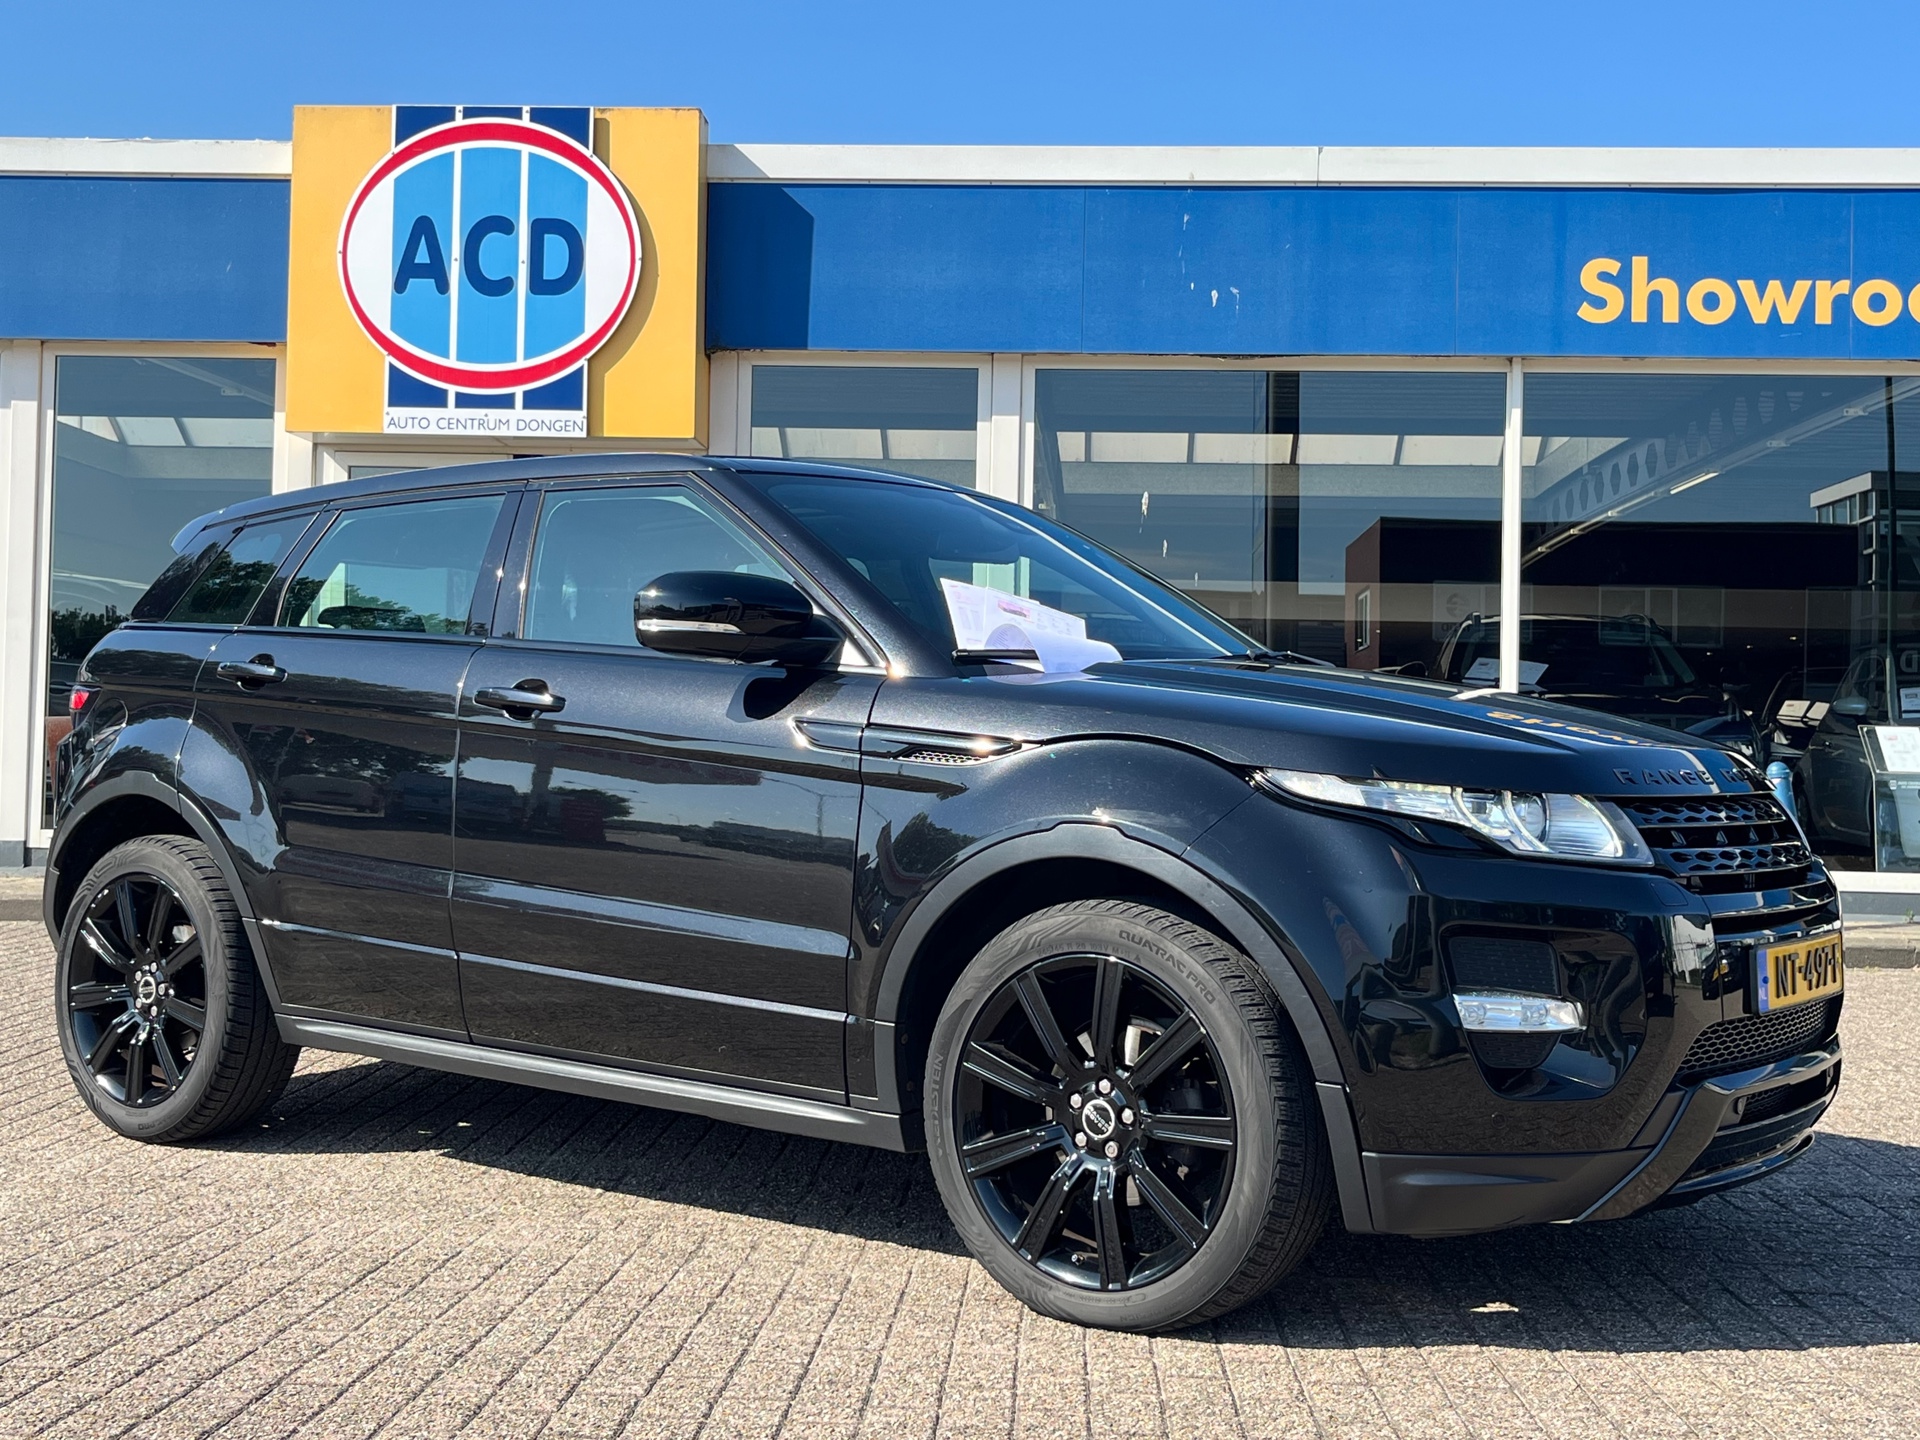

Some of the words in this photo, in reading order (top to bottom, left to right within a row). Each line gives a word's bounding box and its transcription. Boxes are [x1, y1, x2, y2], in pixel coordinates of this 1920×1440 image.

[393, 215, 584, 297] ACD
[1576, 256, 1920, 326] Showro
[387, 417, 431, 430] AUTO
[436, 417, 510, 431] CENTRUM
[516, 419, 584, 432] DONGEN
[1613, 768, 1715, 786] RANGE
[1119, 930, 1187, 974] QUATRAC
[1185, 968, 1216, 1005] PRO
